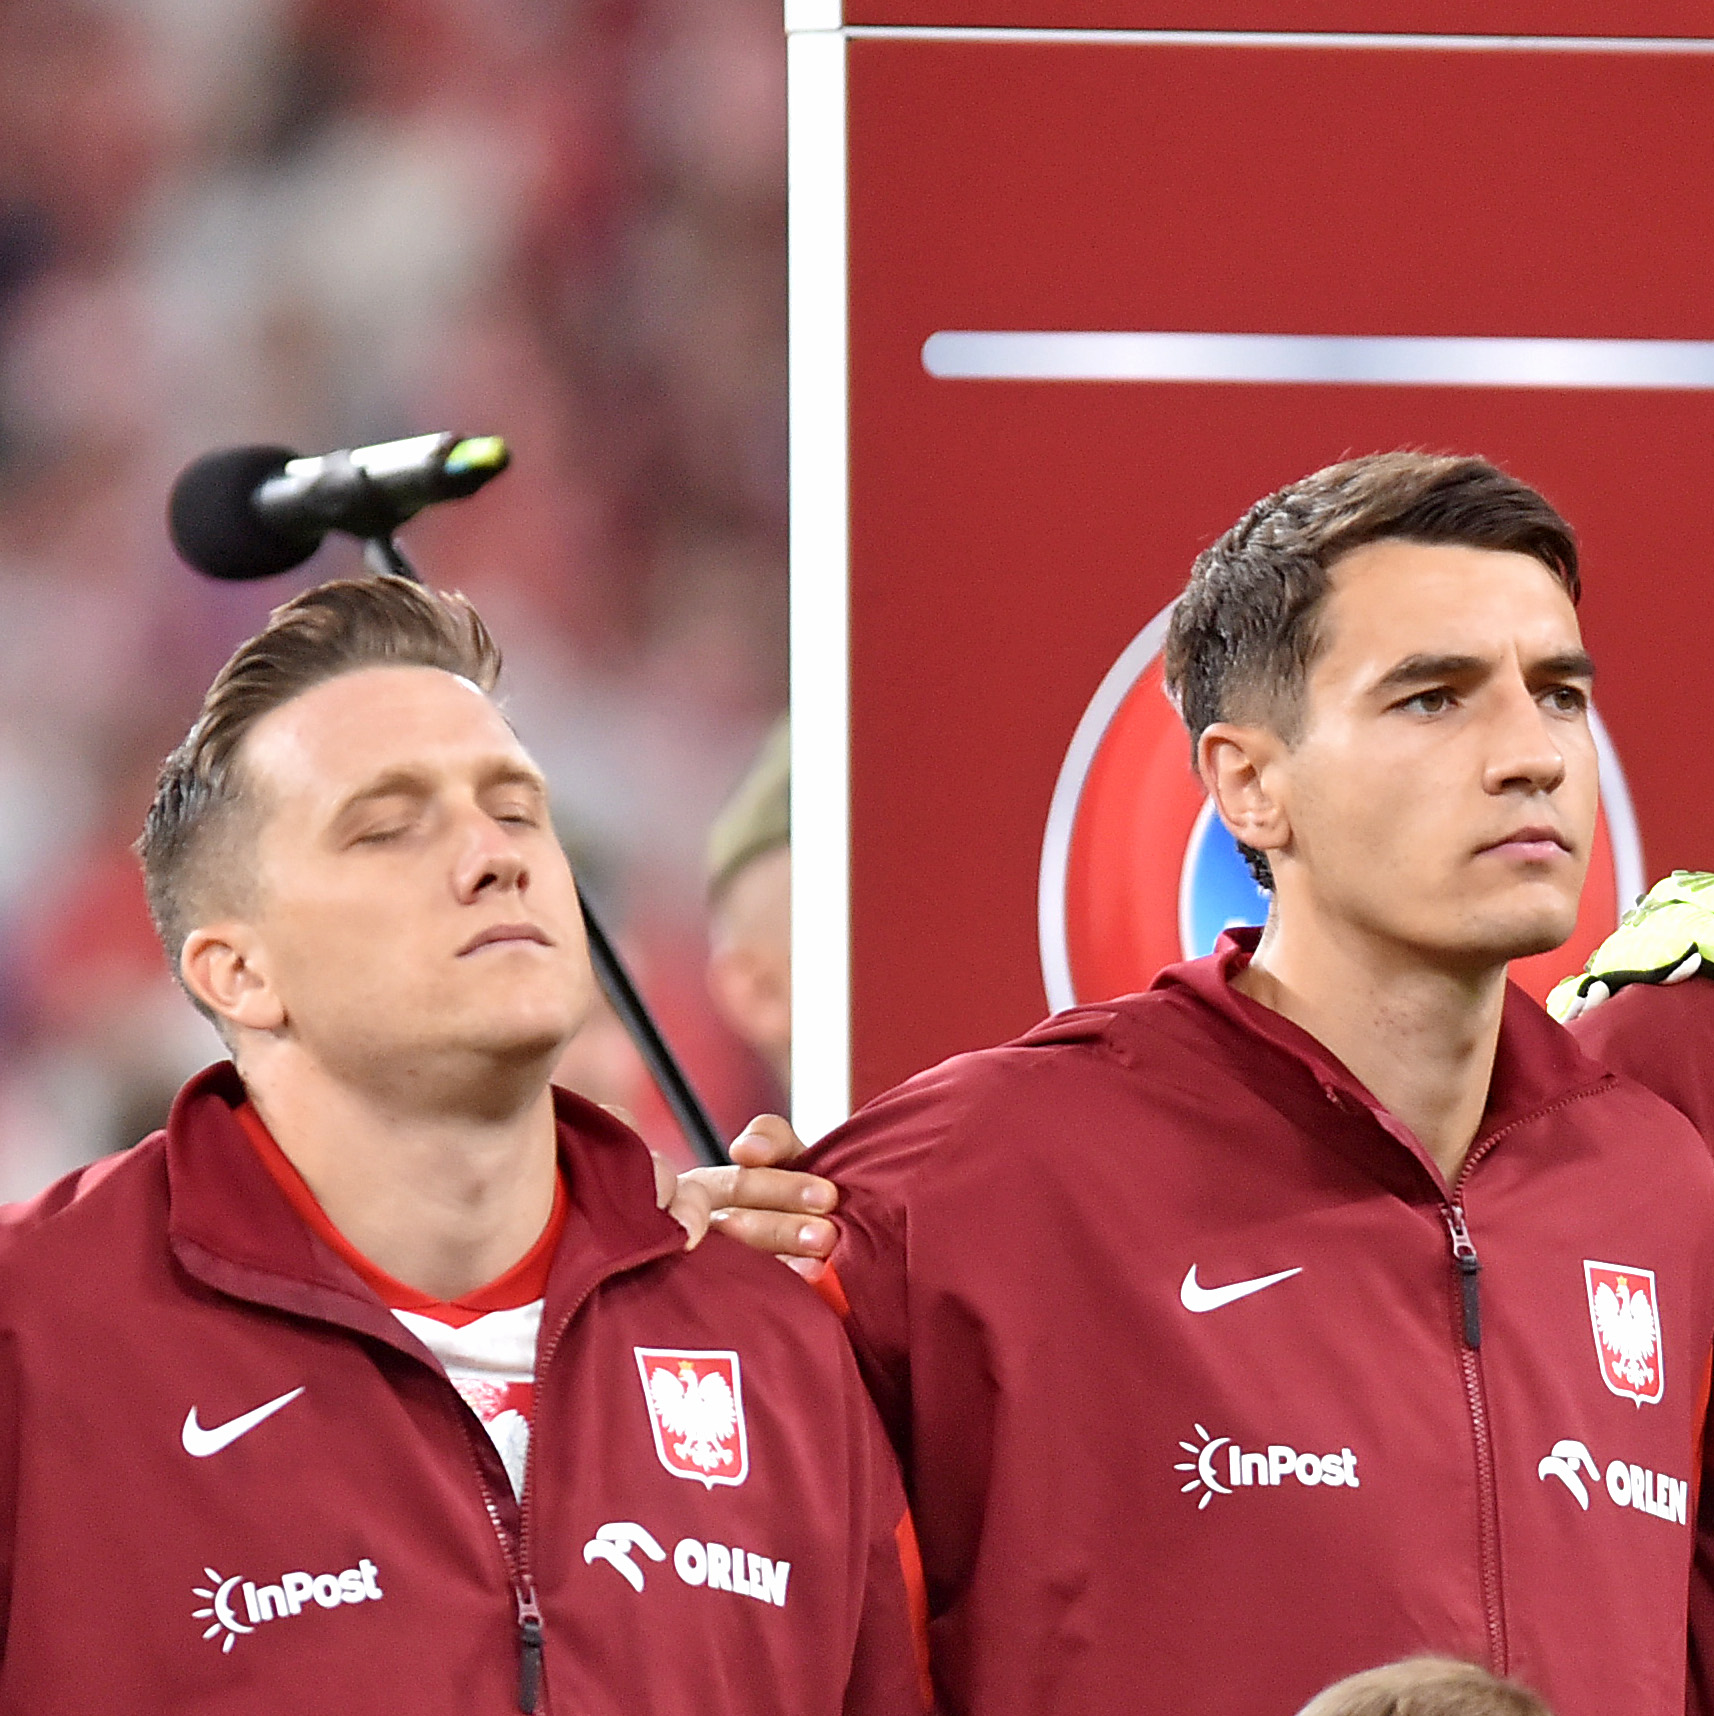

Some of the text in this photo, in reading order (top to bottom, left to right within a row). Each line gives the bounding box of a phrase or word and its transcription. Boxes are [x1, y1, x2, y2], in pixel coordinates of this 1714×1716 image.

[1229, 1445, 1360, 1488] InPost
[1605, 1459, 1688, 1526] ORLEN
[243, 1558, 383, 1624] InPost
[673, 1538, 792, 1608] ORLEN
